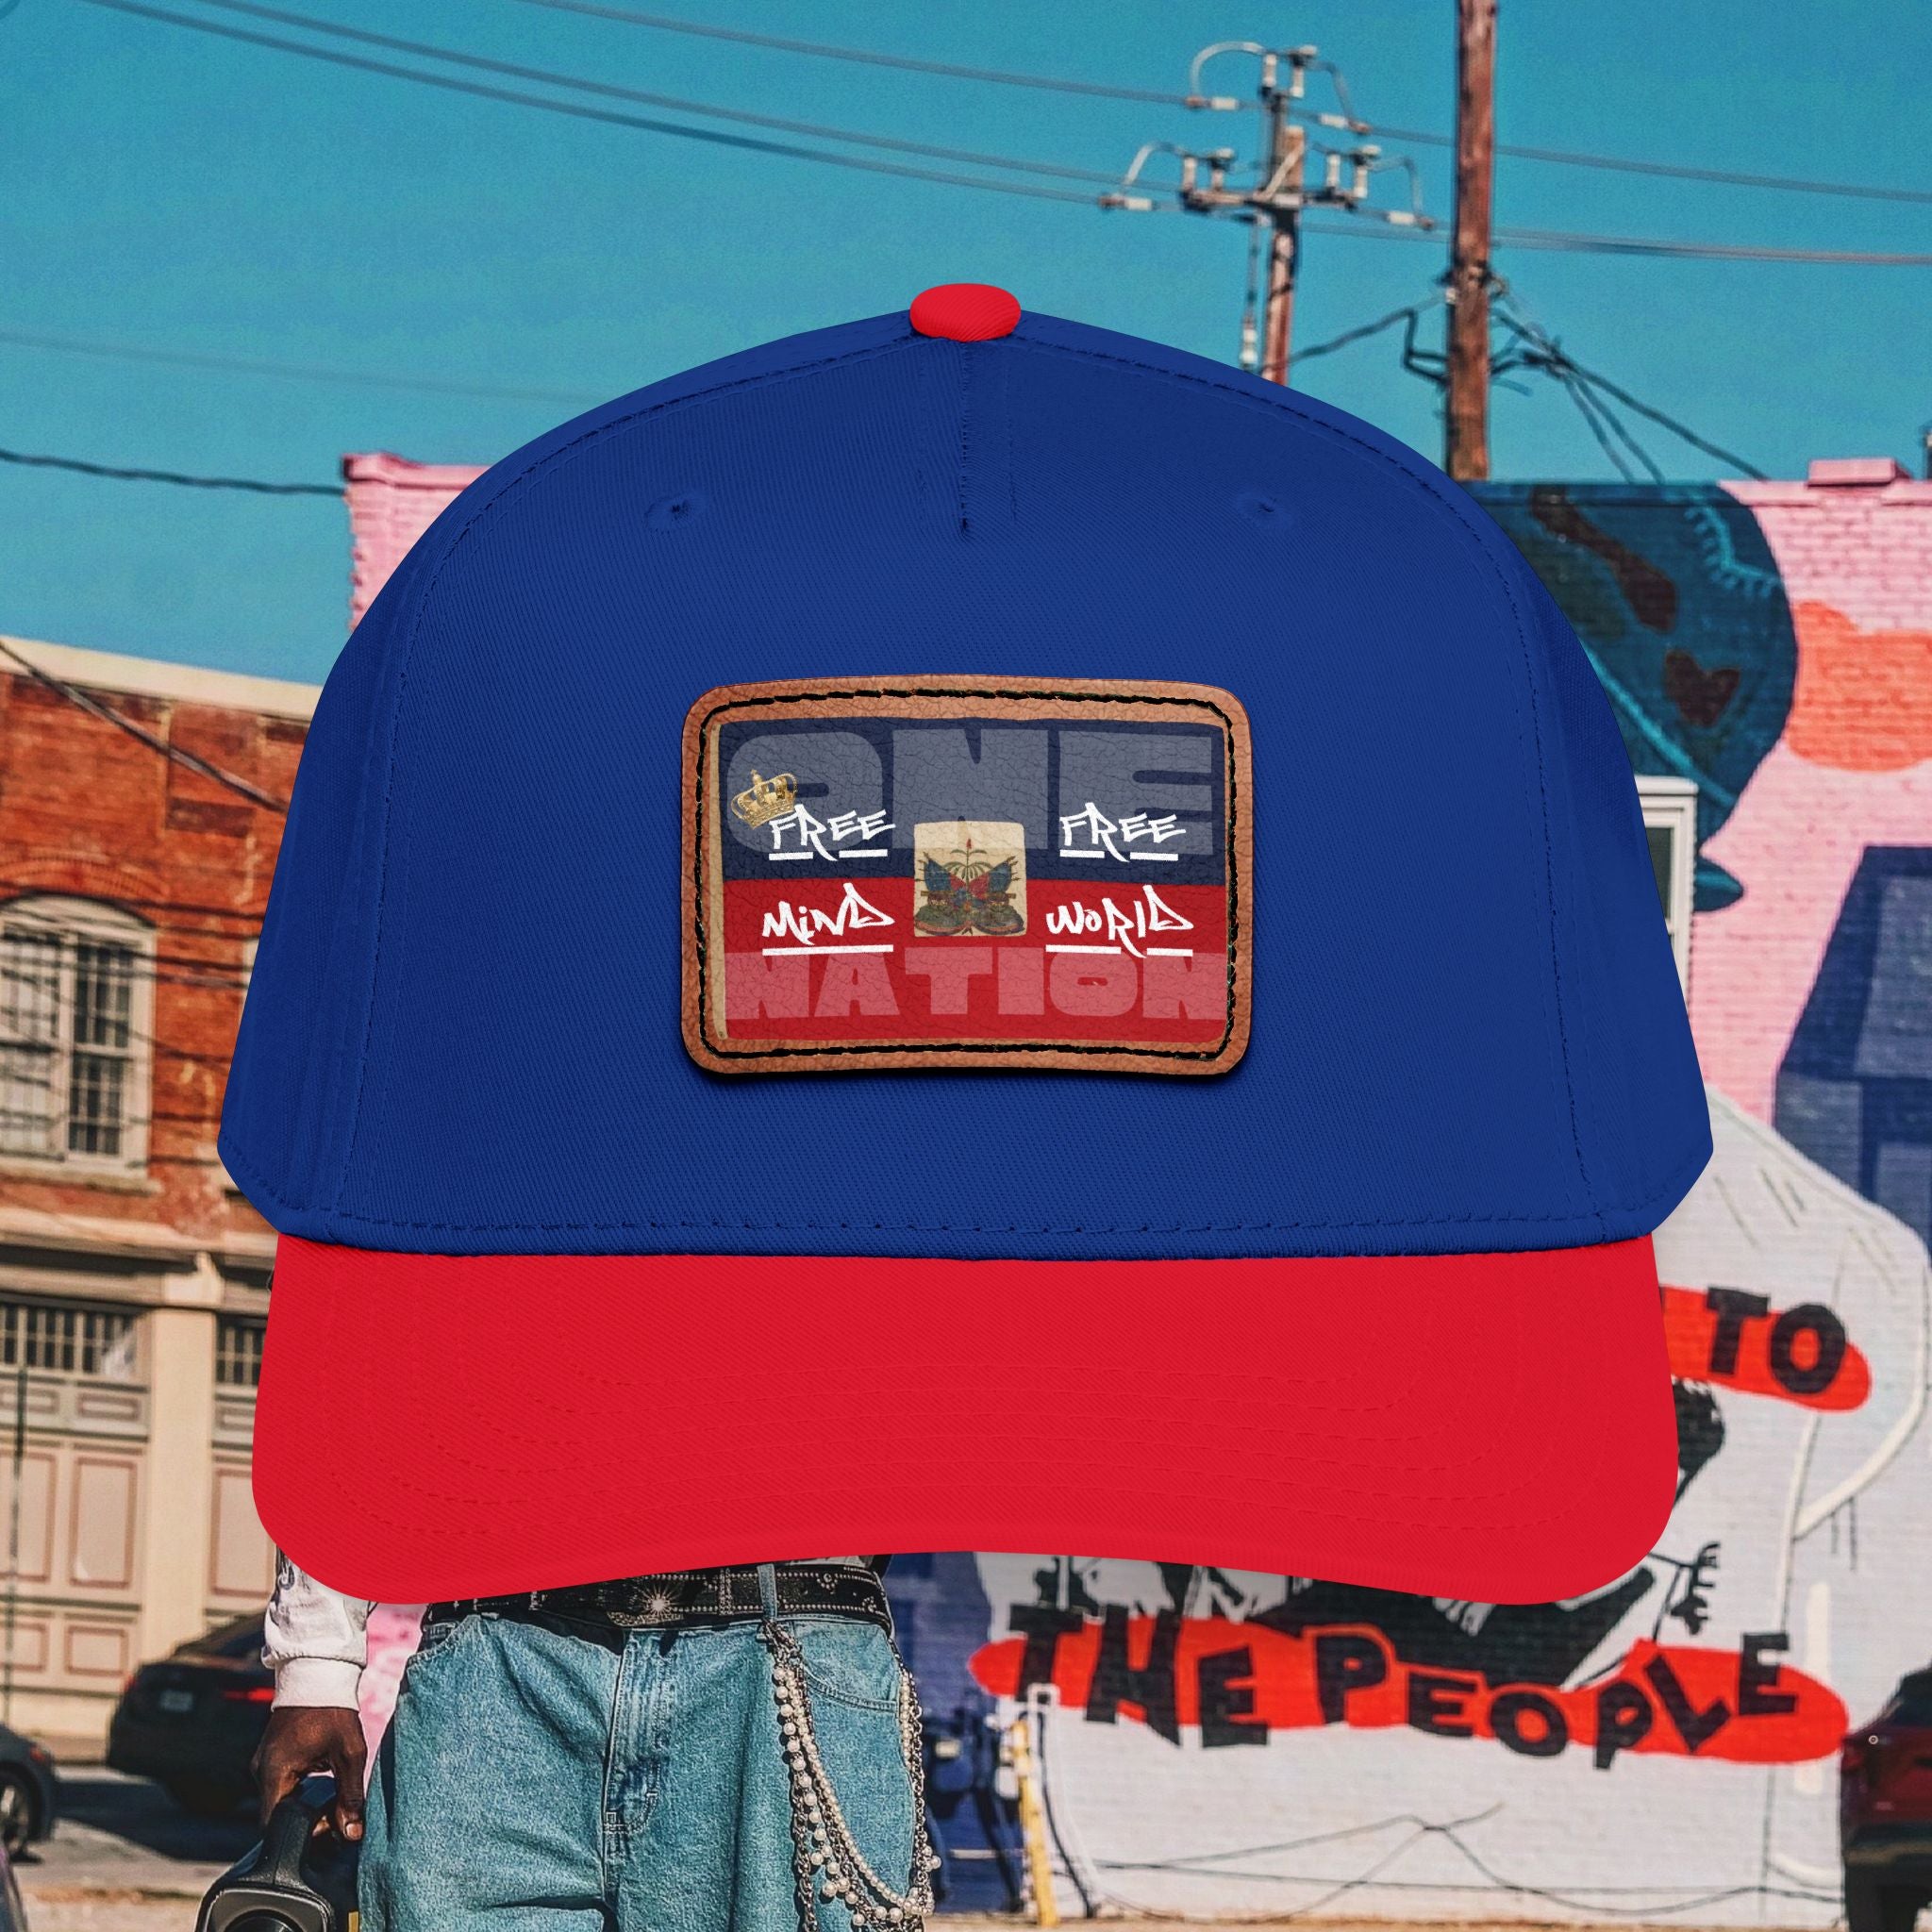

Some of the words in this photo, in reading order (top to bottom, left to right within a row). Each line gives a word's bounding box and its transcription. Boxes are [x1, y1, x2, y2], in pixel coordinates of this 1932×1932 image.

[726, 728, 1214, 856] ONE
[769, 804, 896, 862] FREE
[1059, 802, 1187, 862] FREE
[724, 946, 1227, 1020] NATION
[1706, 1287, 1846, 1395] TO
[1009, 1603, 1269, 1748] THE
[1313, 1632, 1797, 1771] PEOPLE
